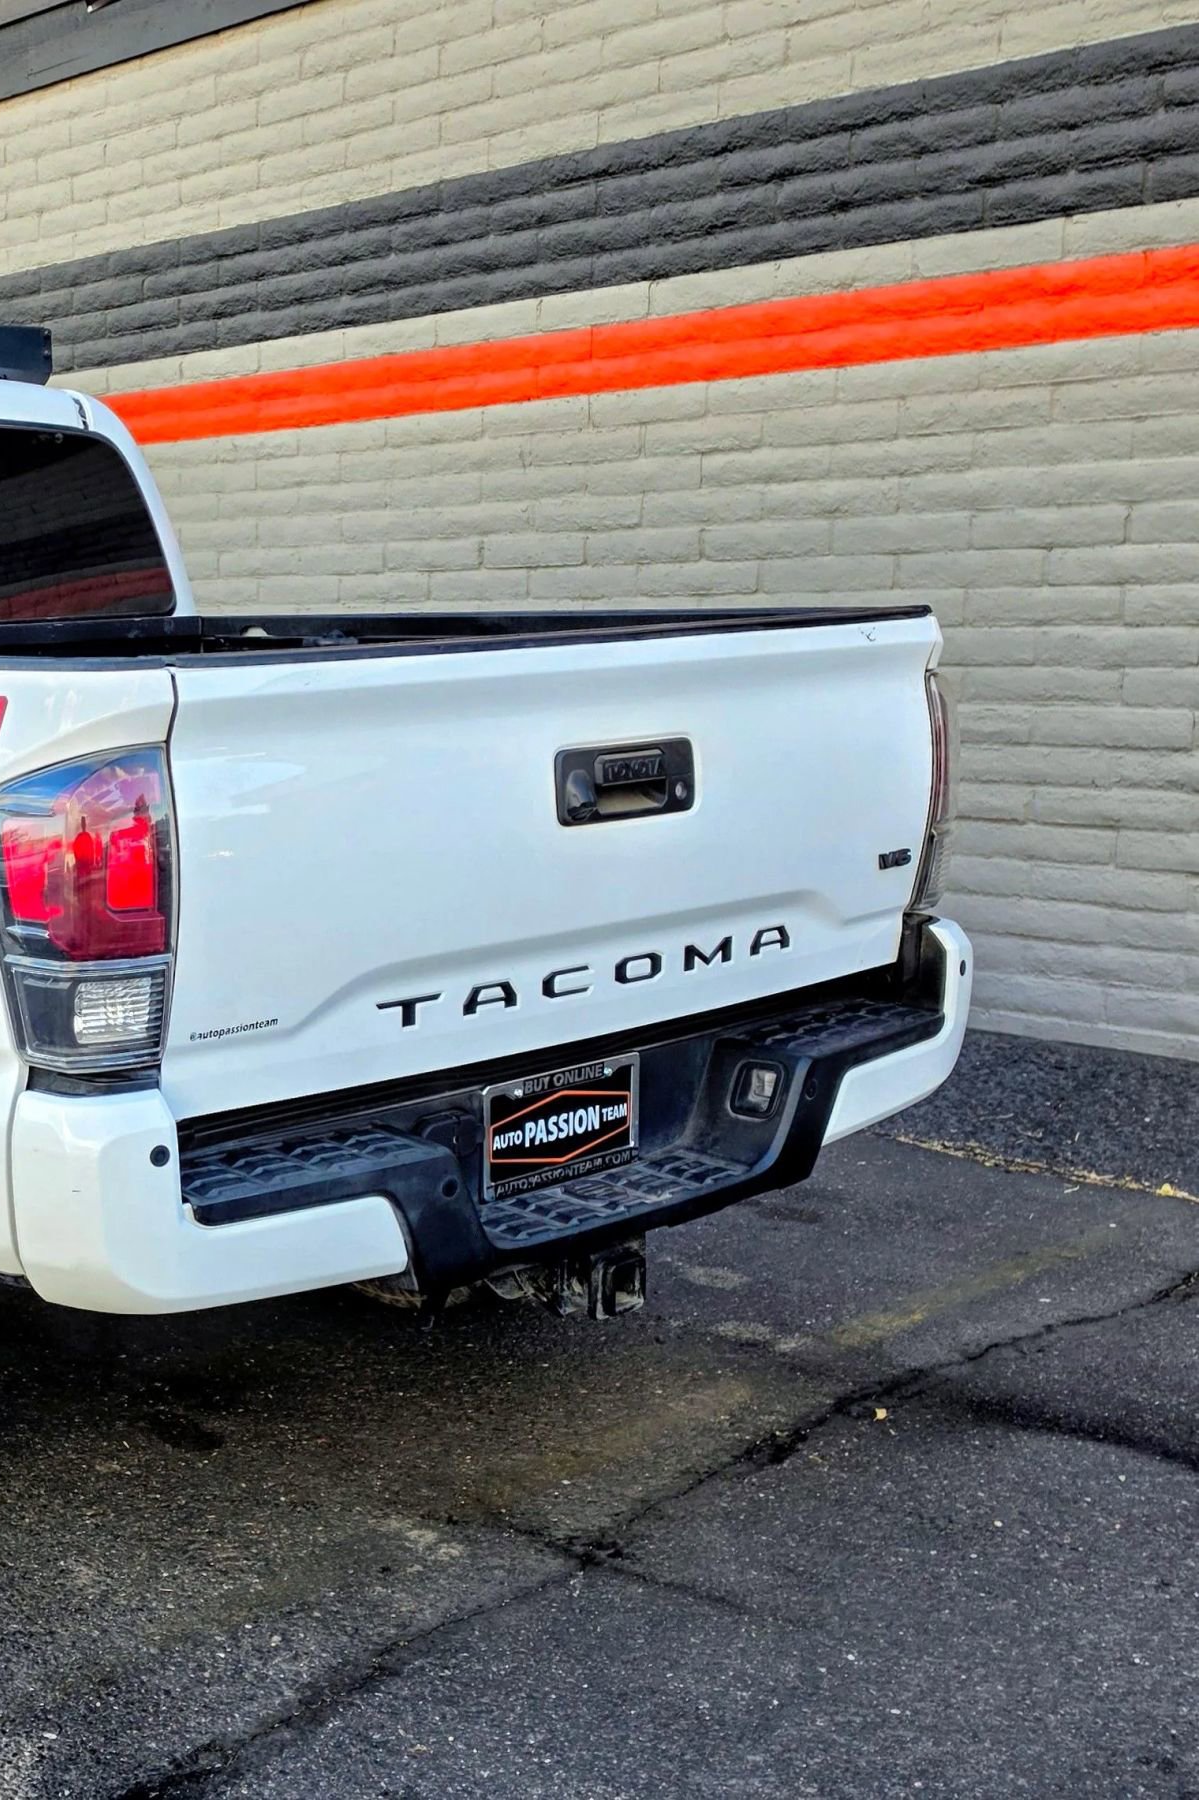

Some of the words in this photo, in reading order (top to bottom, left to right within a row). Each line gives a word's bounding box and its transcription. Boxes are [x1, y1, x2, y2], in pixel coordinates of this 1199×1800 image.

[376, 924, 791, 1028] TACOMA
[189, 1018, 279, 1041] @autopassionteam
[524, 1077, 550, 1095] BUY
[553, 1064, 604, 1087] ONLINE
[493, 1130, 523, 1150] AUTO
[524, 1105, 600, 1147] PASSION
[601, 1103, 628, 1122] TEAM
